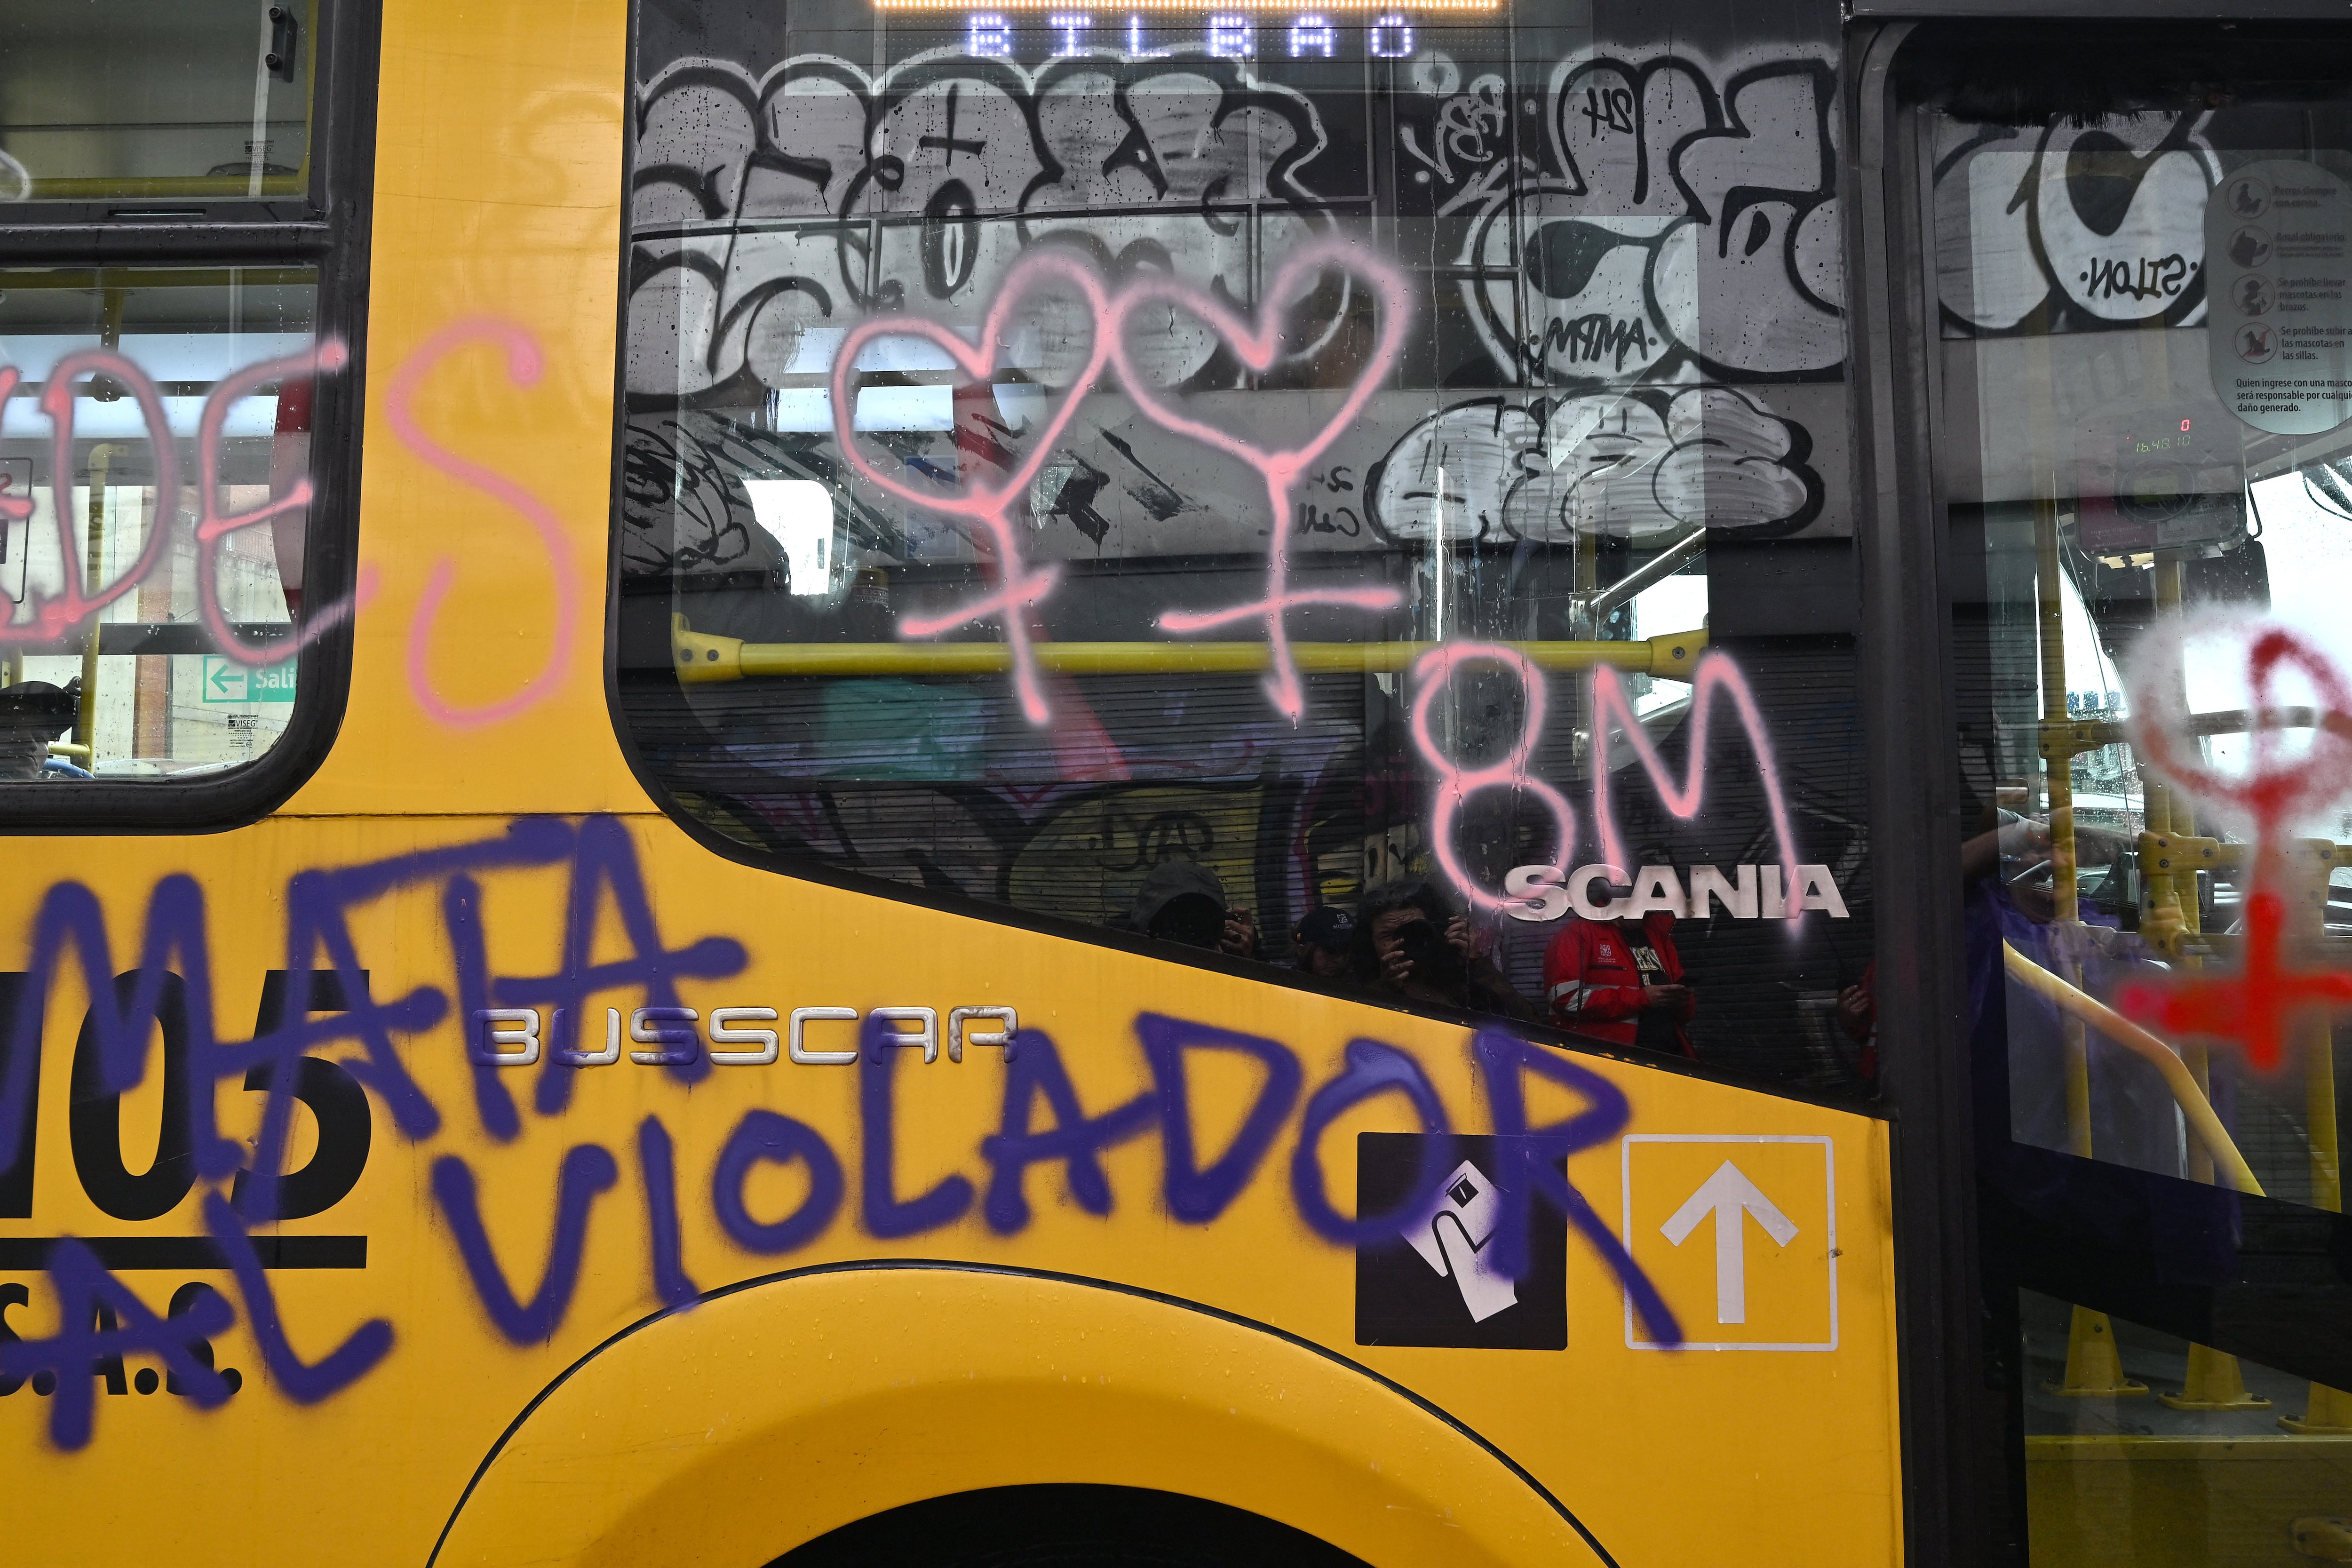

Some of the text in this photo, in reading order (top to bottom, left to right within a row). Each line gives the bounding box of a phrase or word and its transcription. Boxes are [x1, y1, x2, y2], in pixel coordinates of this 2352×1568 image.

[972, 16, 1411, 57] BILBAO
[2279, 278, 2288, 287] Se
[2323, 278, 2346, 287] llevar
[2330, 290, 2342, 299] los
[2280, 302, 2309, 311] brazos.
[2281, 326, 2291, 335] Se
[2326, 326, 2346, 335] subir
[2282, 338, 2293, 347] las
[2282, 350, 2319, 359] las sillas.
[2236, 378, 2260, 388] Quien
[2262, 378, 2292, 390] ingrese
[2237, 390, 2254, 399] será
[2256, 390, 2304, 401] responsable
[2306, 391, 2320, 401] por
[2238, 403, 2301, 414] daño generado.
[2181, 419, 2190, 431] 0
[1412, 640, 1804, 935] 8M
[1504, 864, 1850, 921] SCANIA
[472, 1006, 1018, 1067] BUSSCAR
[429, 1009, 1684, 1353] VIOLADOR
